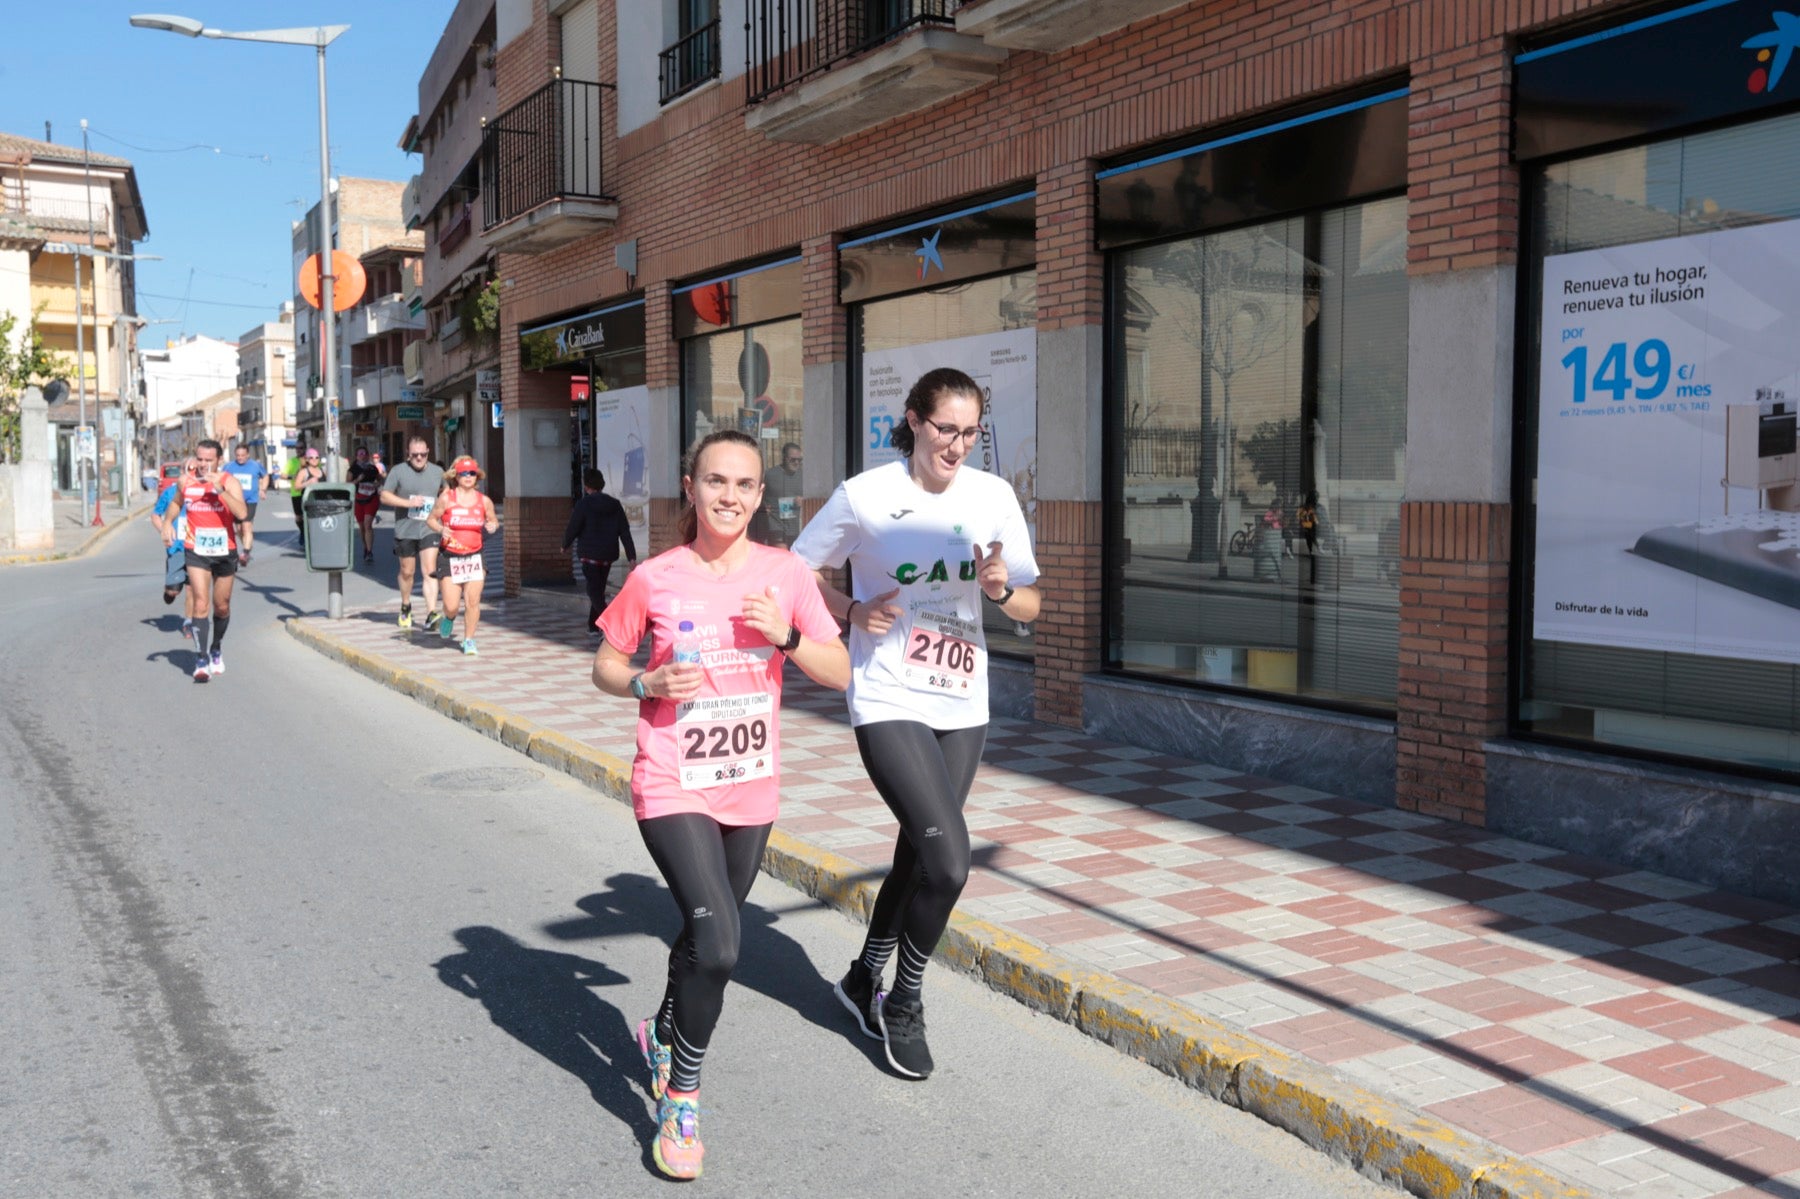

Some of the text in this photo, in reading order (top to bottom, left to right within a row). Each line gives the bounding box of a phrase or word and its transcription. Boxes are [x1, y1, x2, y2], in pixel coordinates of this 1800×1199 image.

[1564, 265, 1707, 295] Renueva tu hogar,
[1563, 284, 1704, 314] renueva tu ilusión
[568, 322, 605, 348] CaixaBank
[1561, 326, 1585, 342] por
[1561, 338, 1671, 403] 149
[1676, 383, 1712, 397] mes
[201, 536, 223, 547] 734
[453, 563, 481, 575] 2174
[1555, 602, 1649, 617] Disfrutar de la vida
[910, 634, 974, 673] 2106
[702, 700, 719, 709] GRAN
[720, 698, 742, 708] PREMIO
[684, 719, 767, 760] 2209
